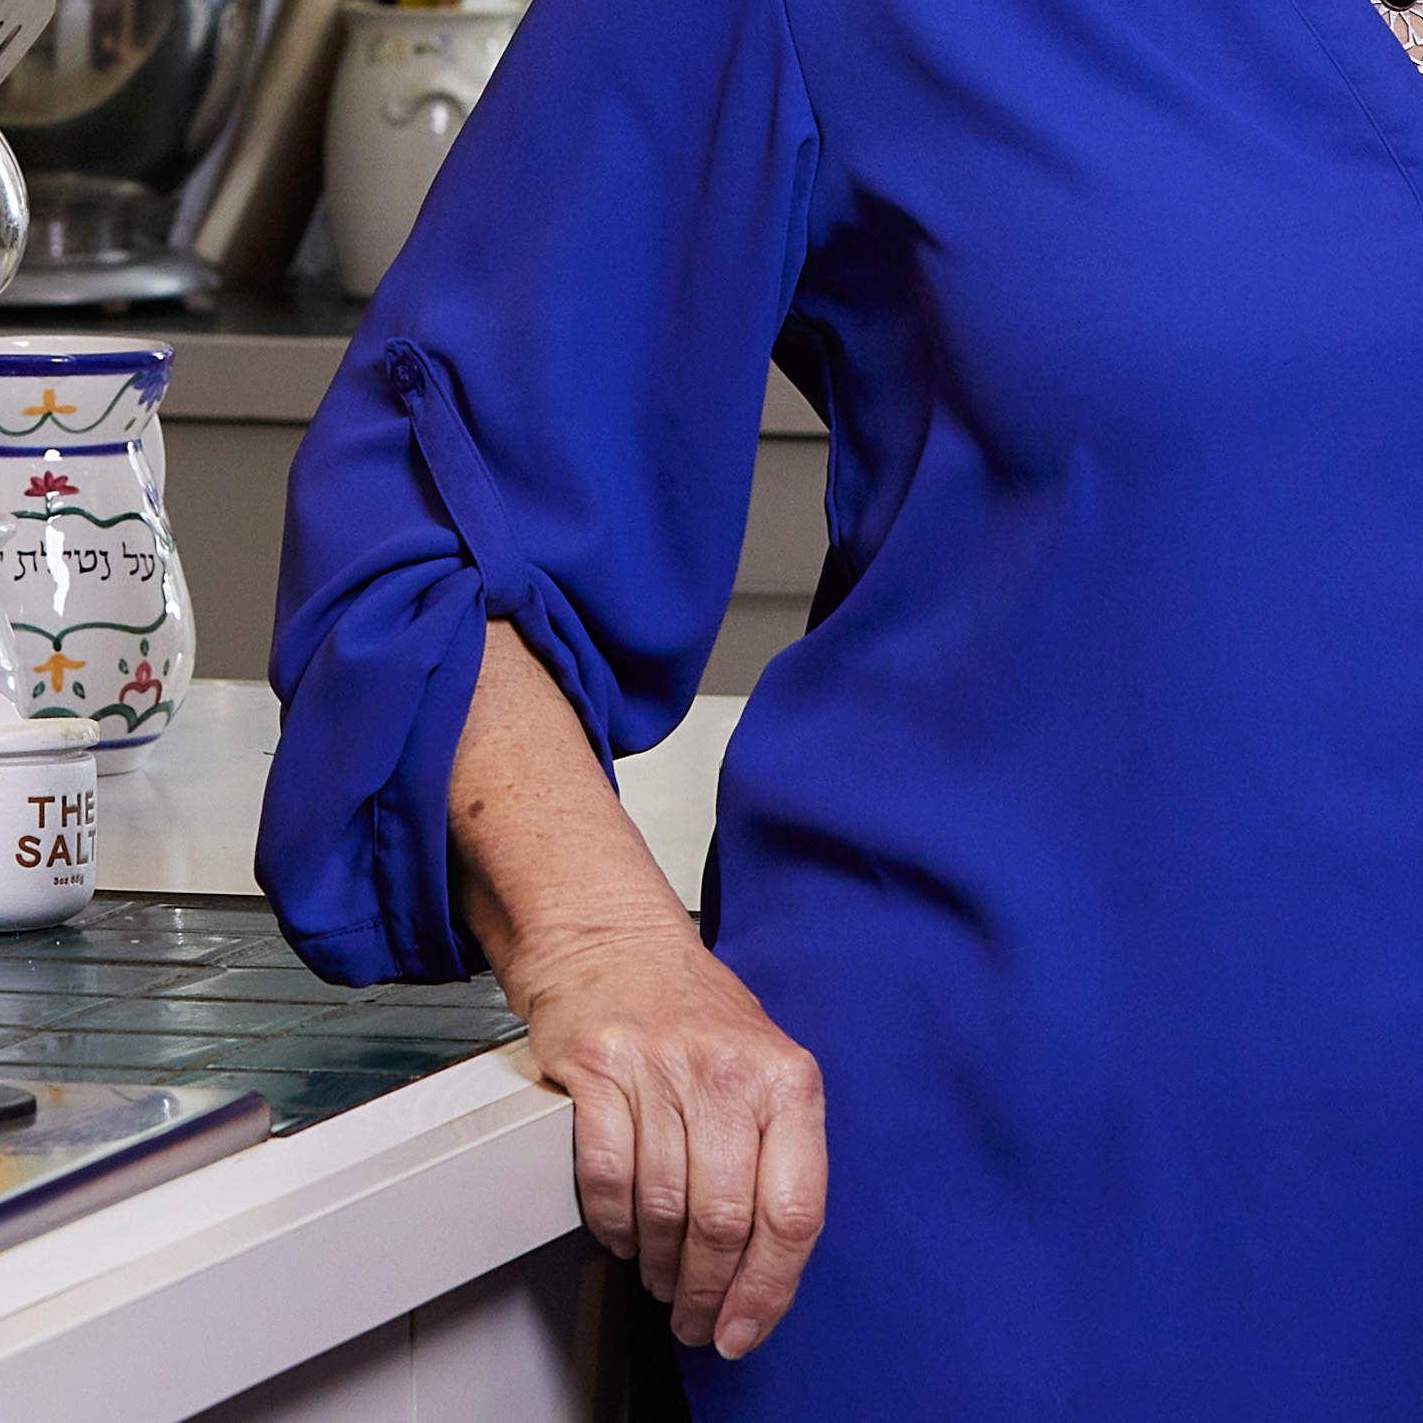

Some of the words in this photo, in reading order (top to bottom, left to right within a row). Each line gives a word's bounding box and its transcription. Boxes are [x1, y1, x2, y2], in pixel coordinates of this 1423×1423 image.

[123, 541, 156, 582] על
[27, 790, 95, 829] THE
[15, 830, 97, 869] SALT
